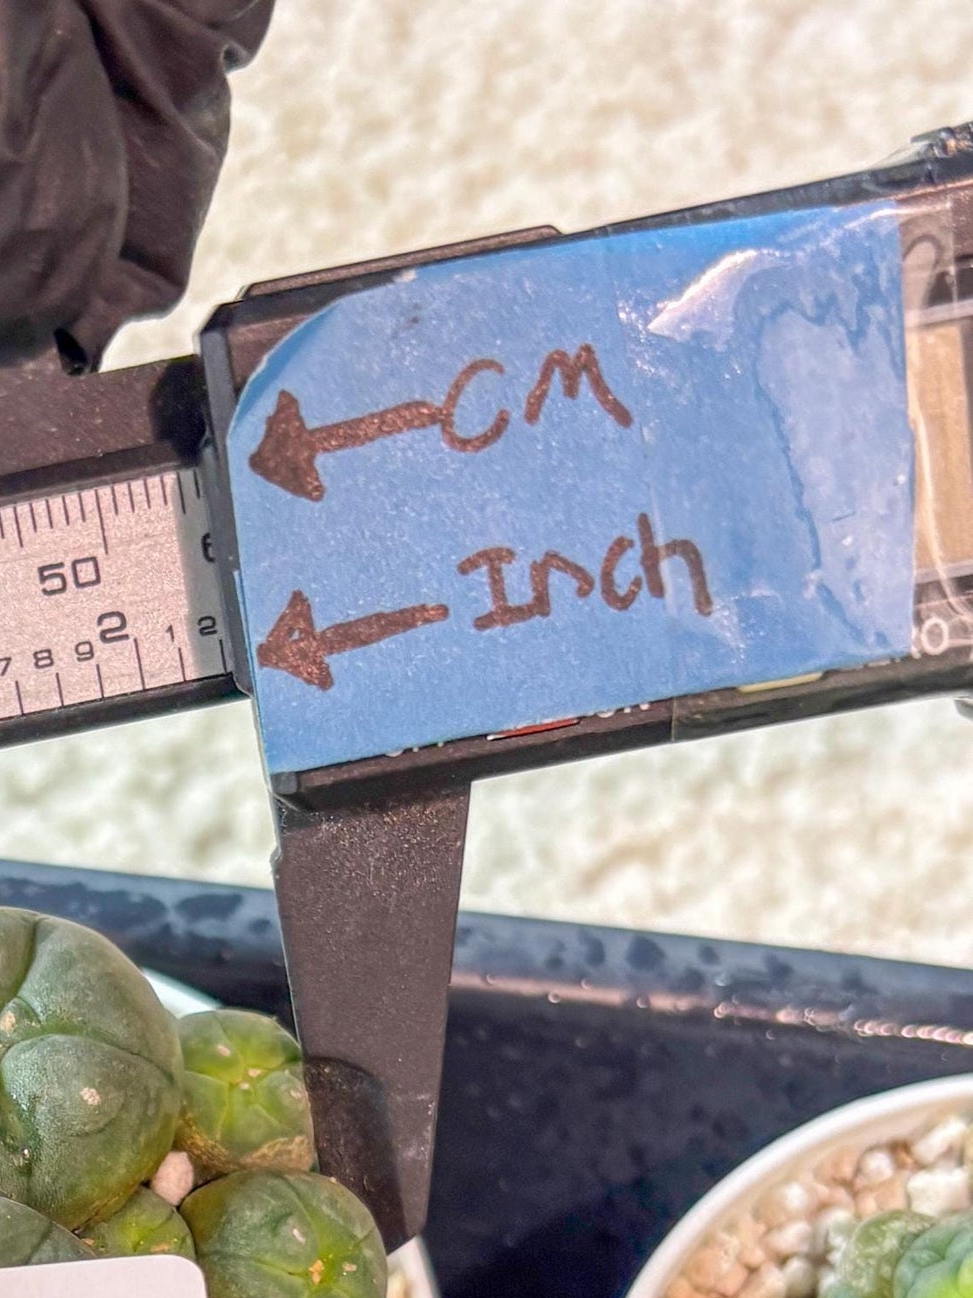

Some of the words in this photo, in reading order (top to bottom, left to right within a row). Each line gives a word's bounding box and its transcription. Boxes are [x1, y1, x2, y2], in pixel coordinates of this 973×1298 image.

[37, 556, 101, 596] 50
[458, 513, 712, 630] Inch
[33, 648, 54, 669] 8
[74, 640, 94, 662] 9
[97, 611, 129, 643] 2
[165, 624, 175, 642] 1
[197, 615, 217, 636] 2
